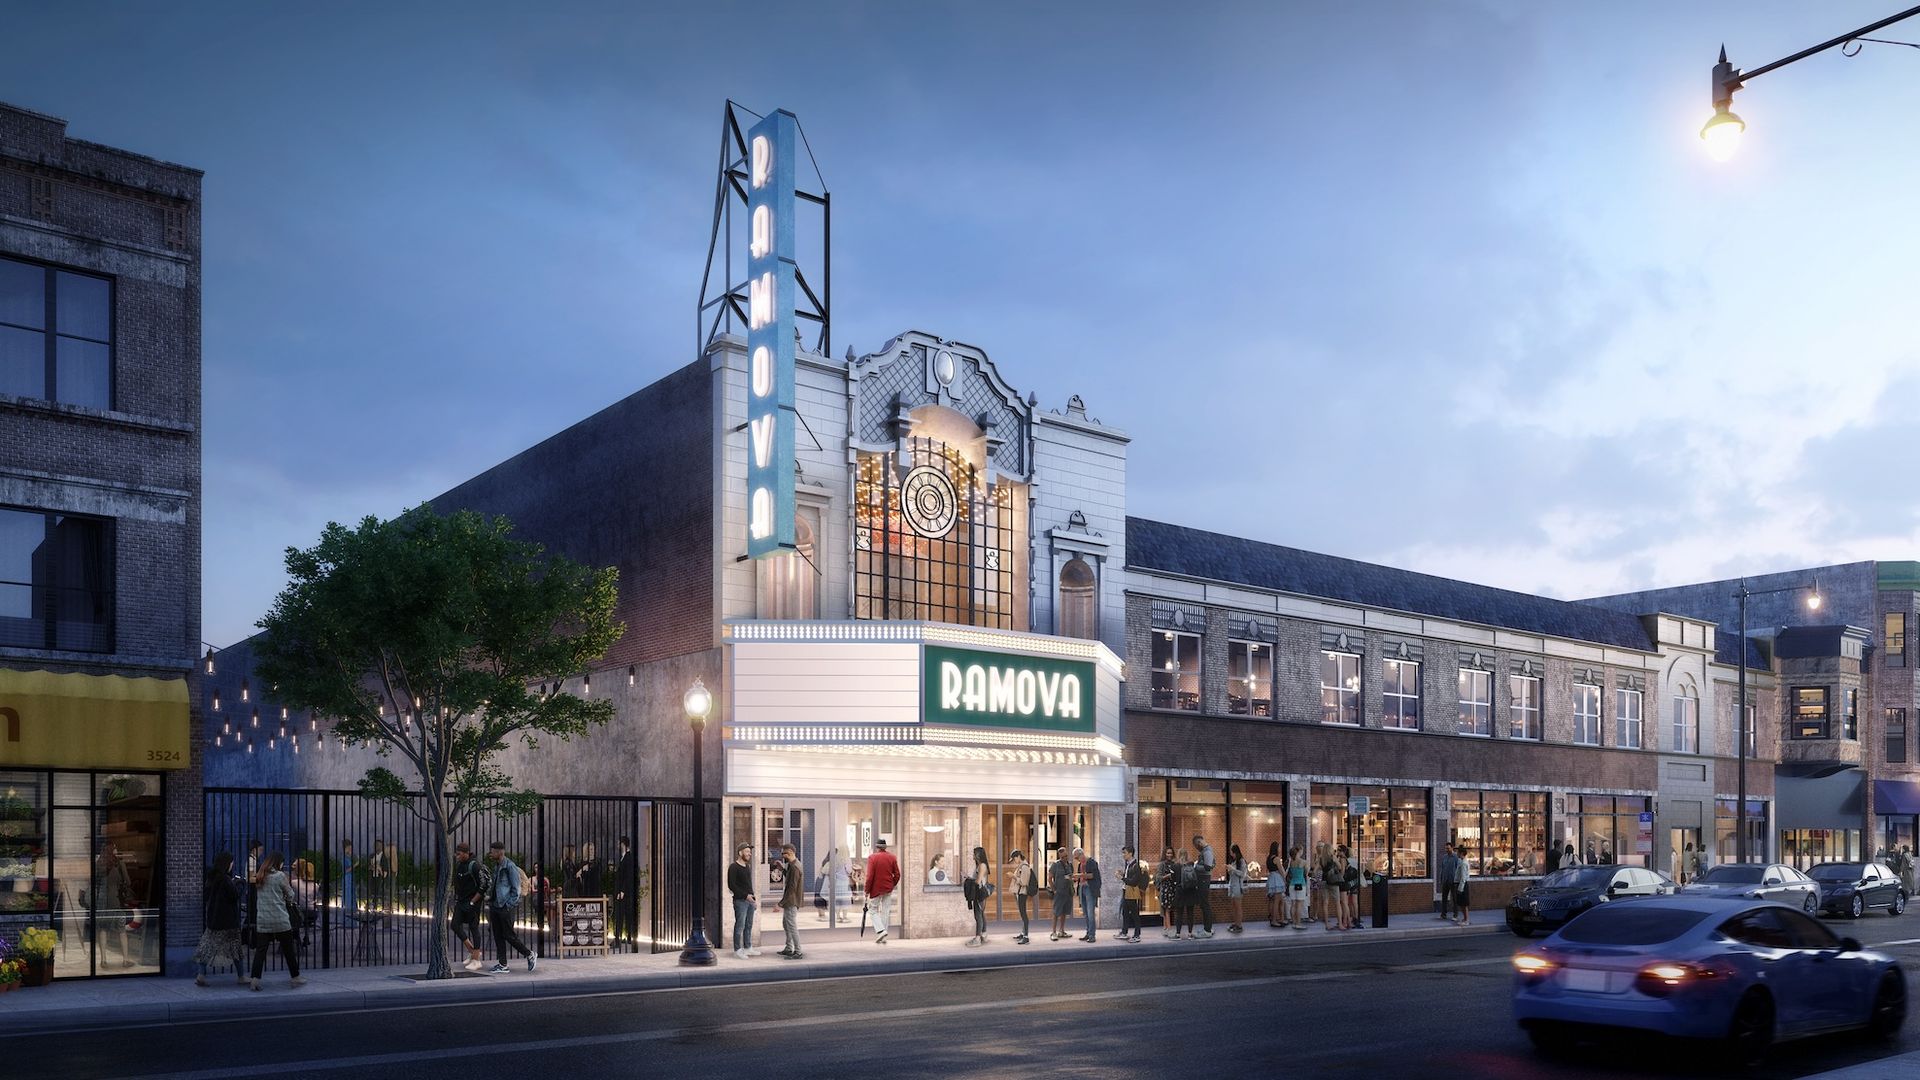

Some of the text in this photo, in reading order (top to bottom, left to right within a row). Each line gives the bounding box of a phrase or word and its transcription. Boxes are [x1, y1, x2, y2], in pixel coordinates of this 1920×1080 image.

[750, 134, 774, 541] RAMOVA
[941, 661, 1081, 719] RAMOVA
[147, 750, 181, 762] 3524
